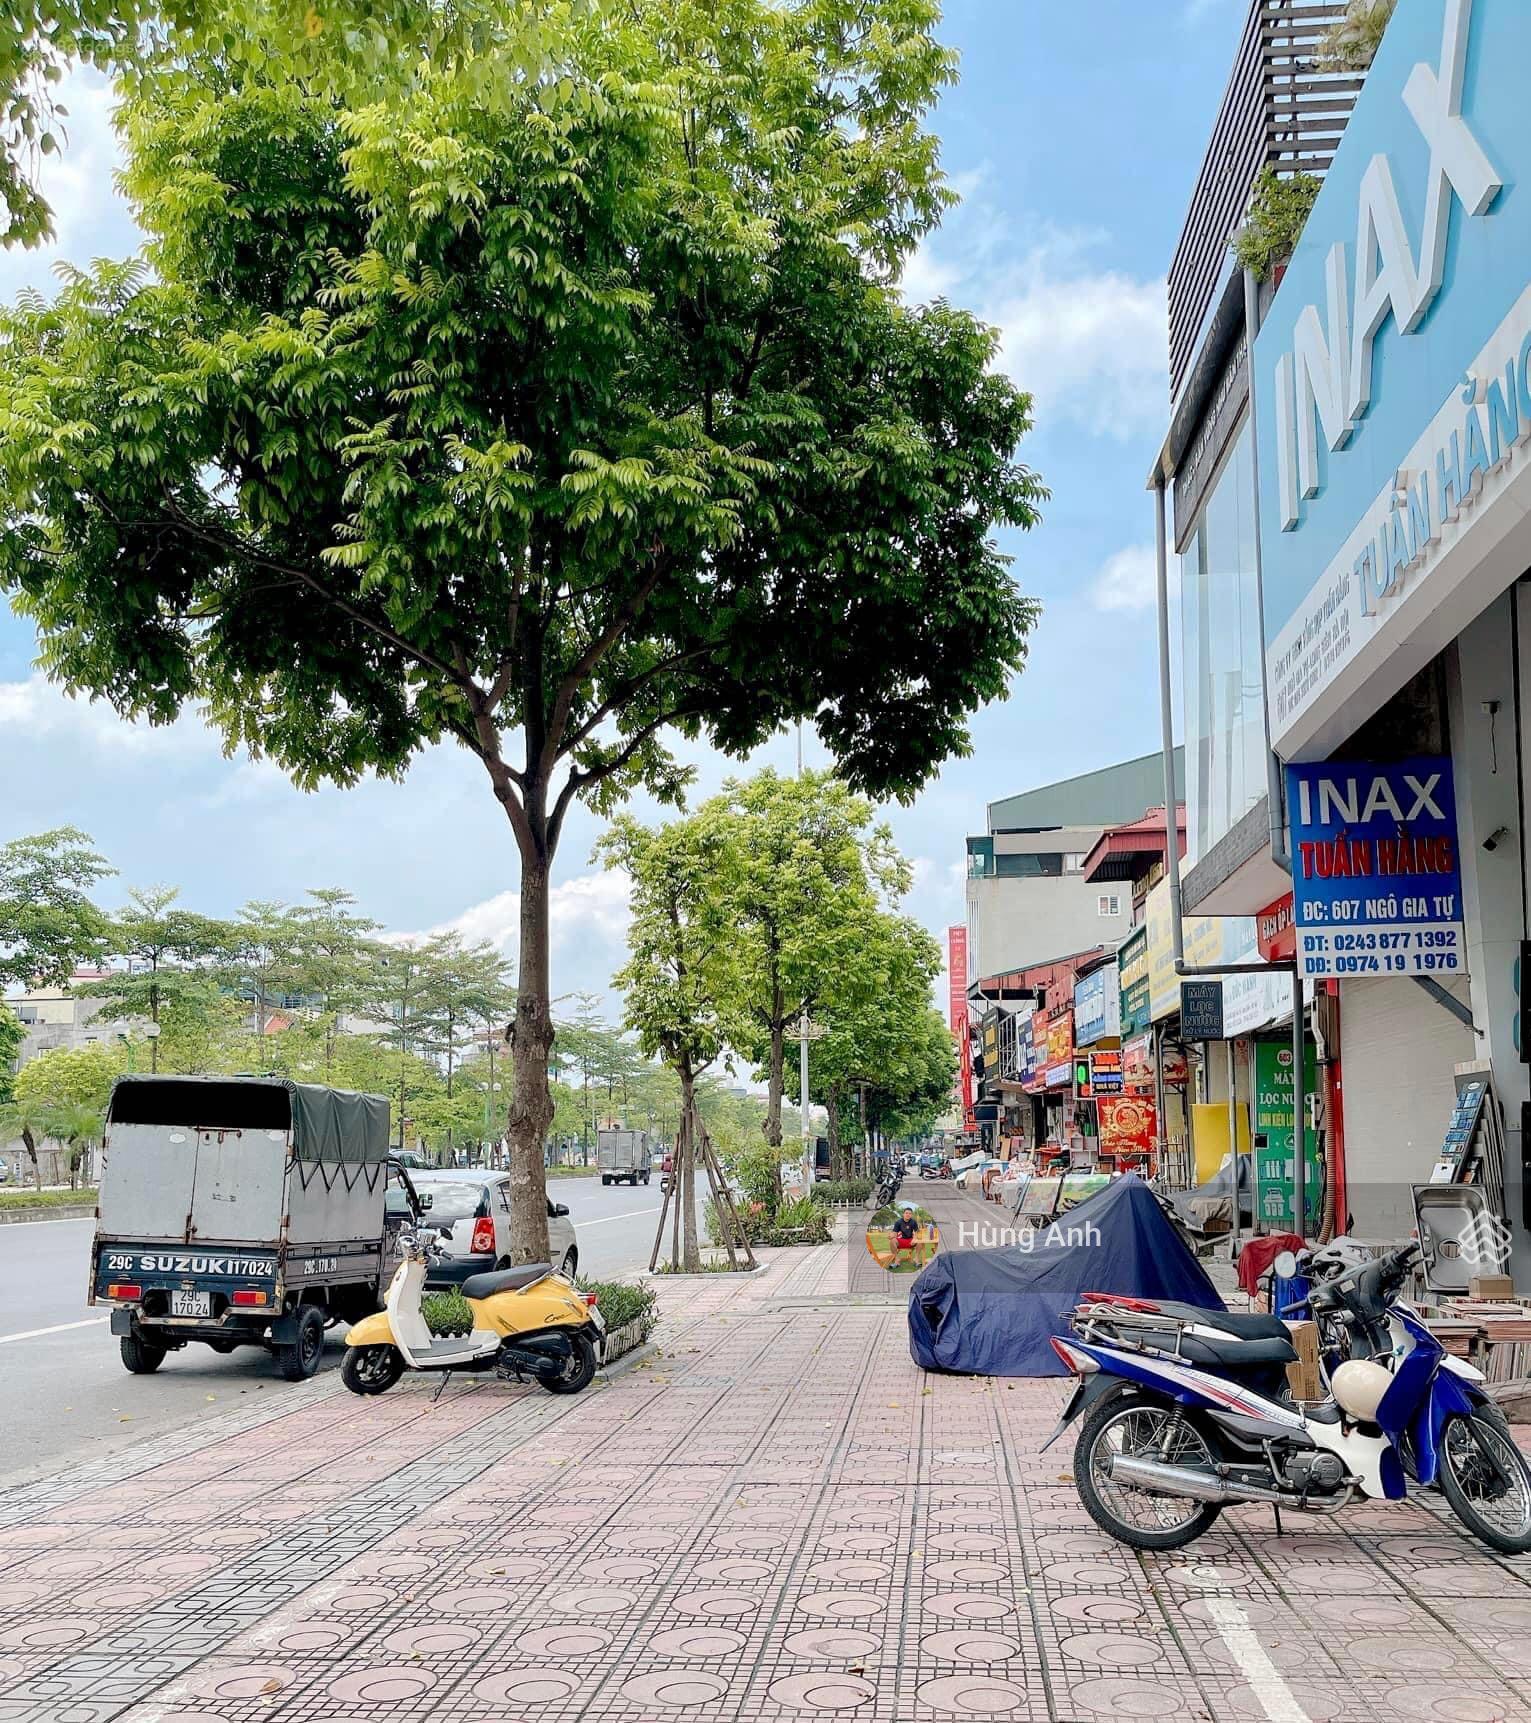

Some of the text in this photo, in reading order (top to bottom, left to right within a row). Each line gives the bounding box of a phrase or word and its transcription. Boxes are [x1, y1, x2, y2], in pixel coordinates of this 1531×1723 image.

[1275, 0, 1503, 532] INAX
[1298, 774, 1446, 825] INAX
[1298, 826, 1372, 879] TUẤN
[1303, 893, 1455, 921] ĐC: 607 NGÔ GIA TỰ
[1304, 931, 1457, 952] ĐT: 0243 877 1392
[1336, 955, 1379, 972] 0974
[1384, 954, 1406, 971] 19
[1414, 953, 1458, 970] 1976
[1187, 985, 1216, 998] MÁY
[1260, 1092, 1311, 1108] LỌC NC
[108, 1255, 272, 1276] 29C SUZUKI 17024
[180, 1290, 200, 1302] 29C
